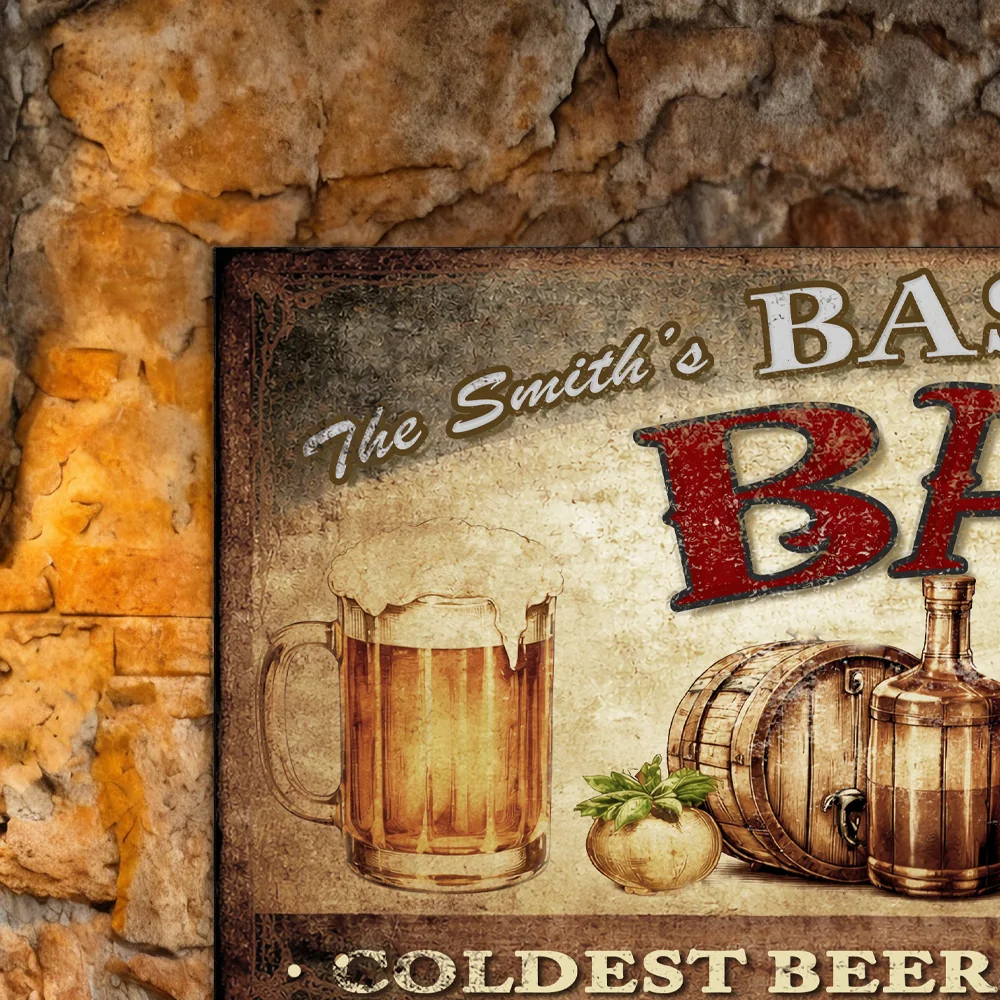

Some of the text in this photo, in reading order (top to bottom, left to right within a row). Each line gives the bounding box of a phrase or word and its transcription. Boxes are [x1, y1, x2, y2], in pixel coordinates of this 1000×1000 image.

[301, 404, 425, 482] The
[447, 322, 711, 438] Smith's
[333, 948, 747, 995] COLDEST
[768, 949, 999, 994] BEER
